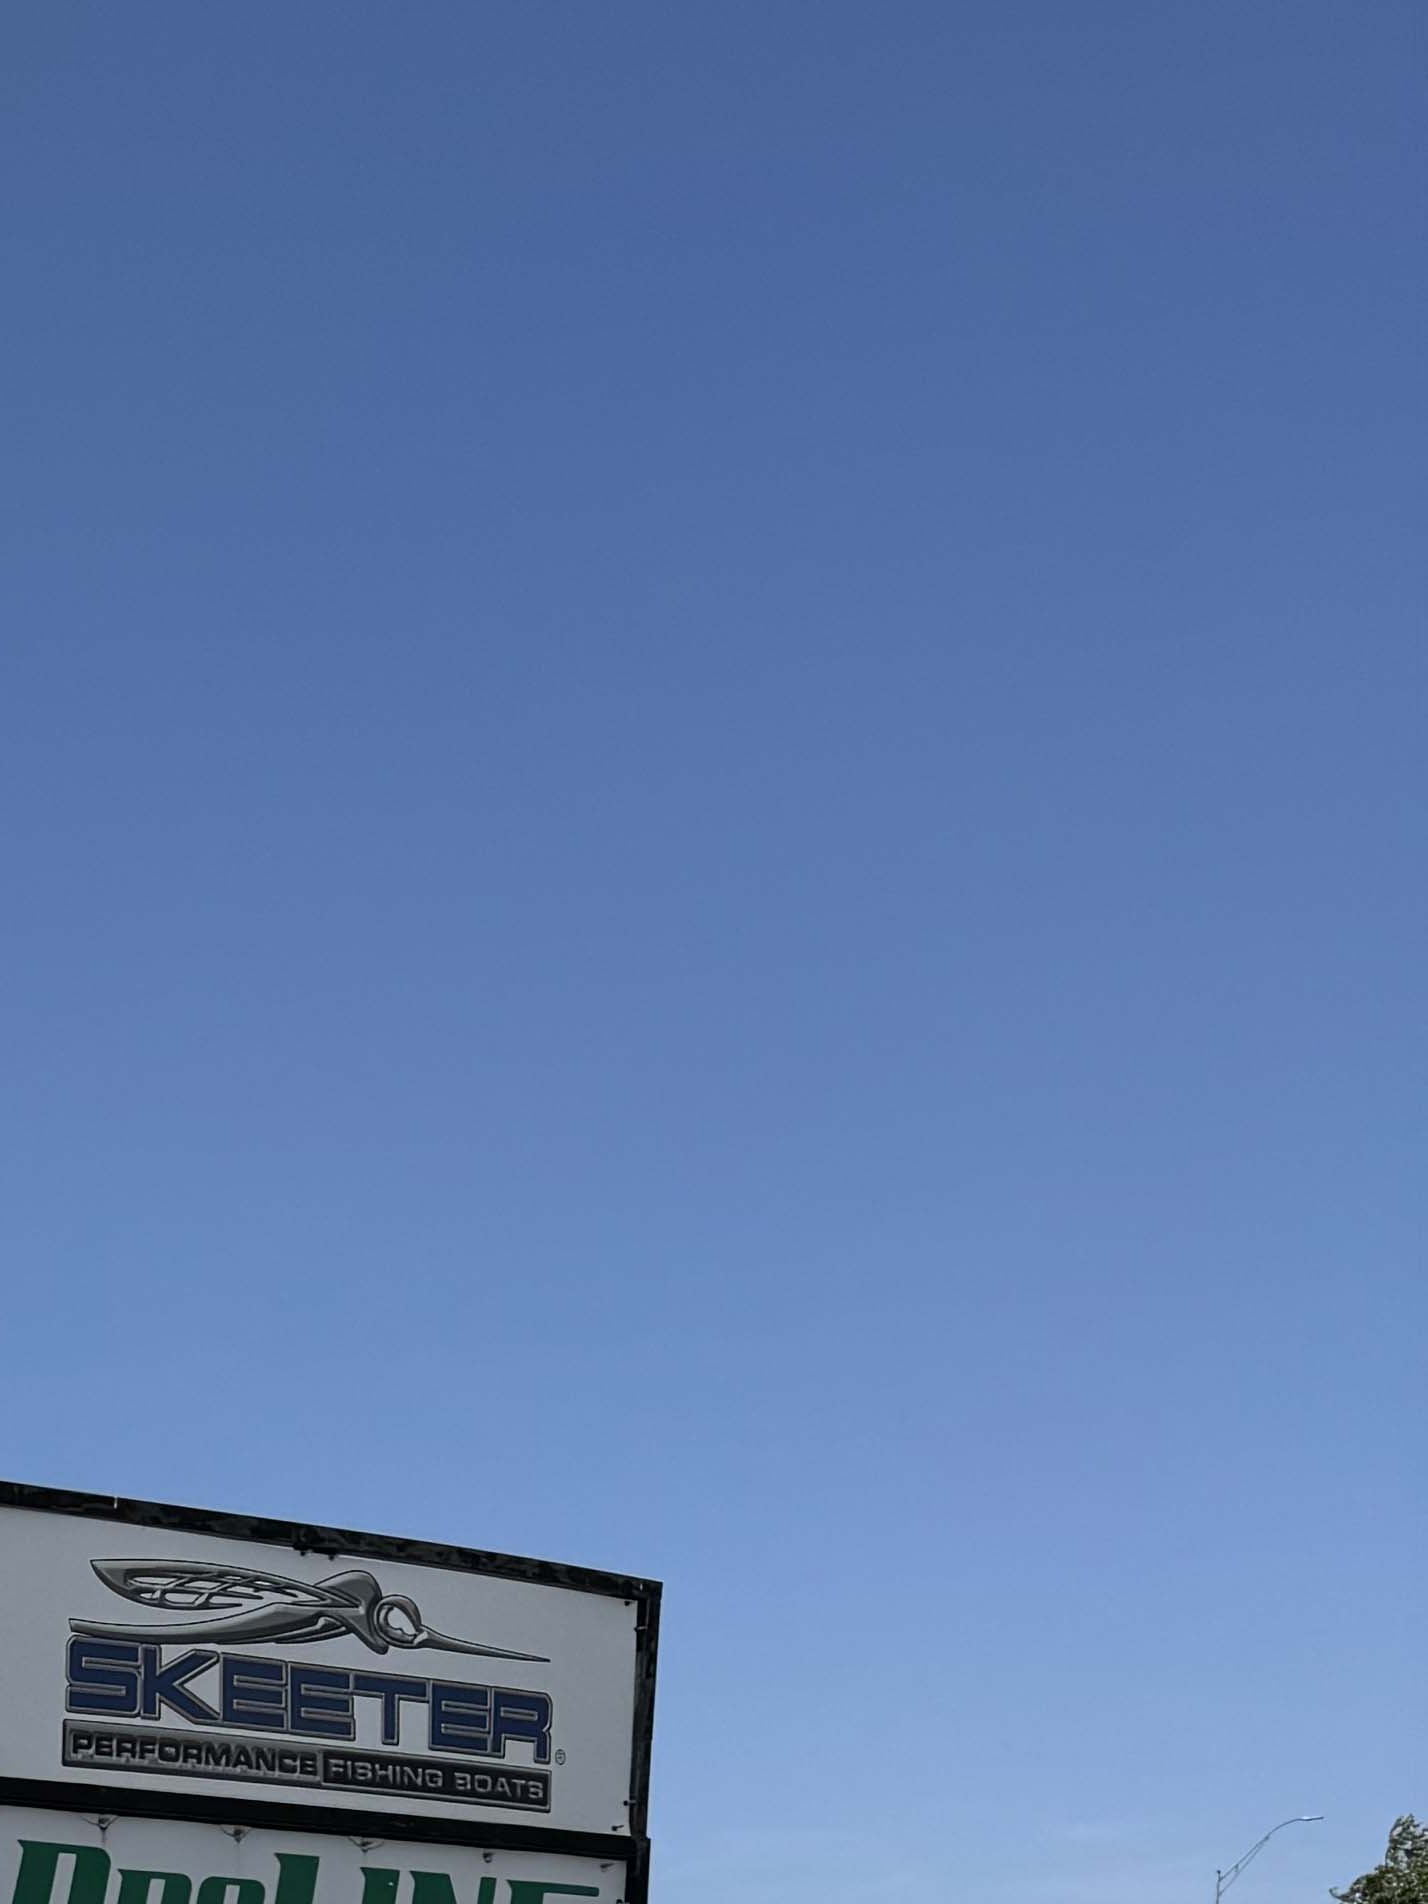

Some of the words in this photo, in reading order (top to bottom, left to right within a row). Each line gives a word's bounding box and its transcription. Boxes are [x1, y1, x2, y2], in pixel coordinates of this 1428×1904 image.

[65, 1634, 554, 1764] SKEETER
[70, 1732, 319, 1778] PERFORMANCE
[329, 1757, 443, 1788] FISHING
[454, 1771, 546, 1800] BOATS
